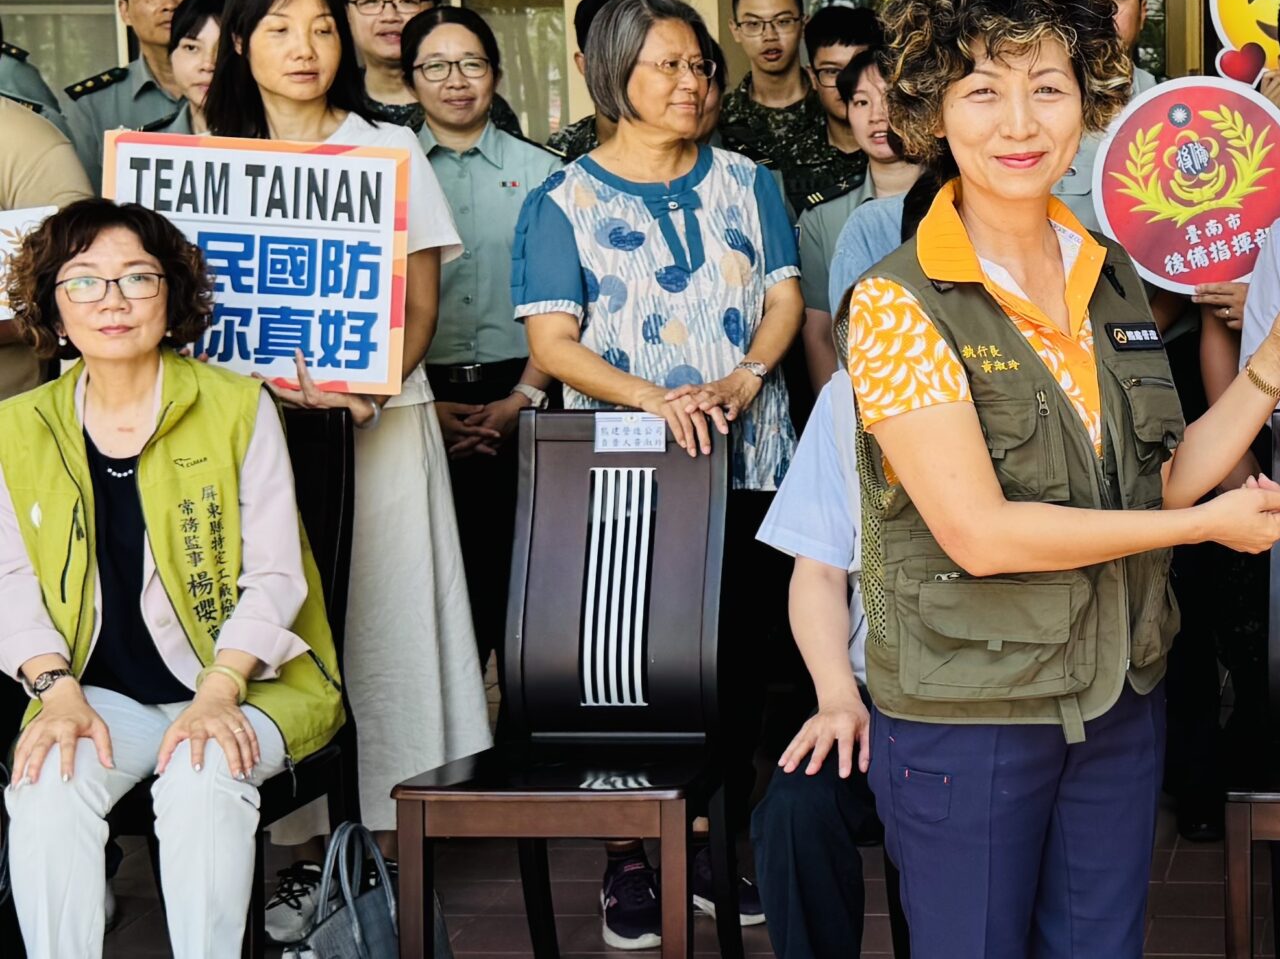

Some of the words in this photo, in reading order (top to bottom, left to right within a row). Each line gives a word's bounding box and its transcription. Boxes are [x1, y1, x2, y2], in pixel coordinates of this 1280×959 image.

[129, 157, 230, 215] TEAM
[245, 164, 382, 224] TAINAN
[1185, 213, 1241, 245] 臺南市
